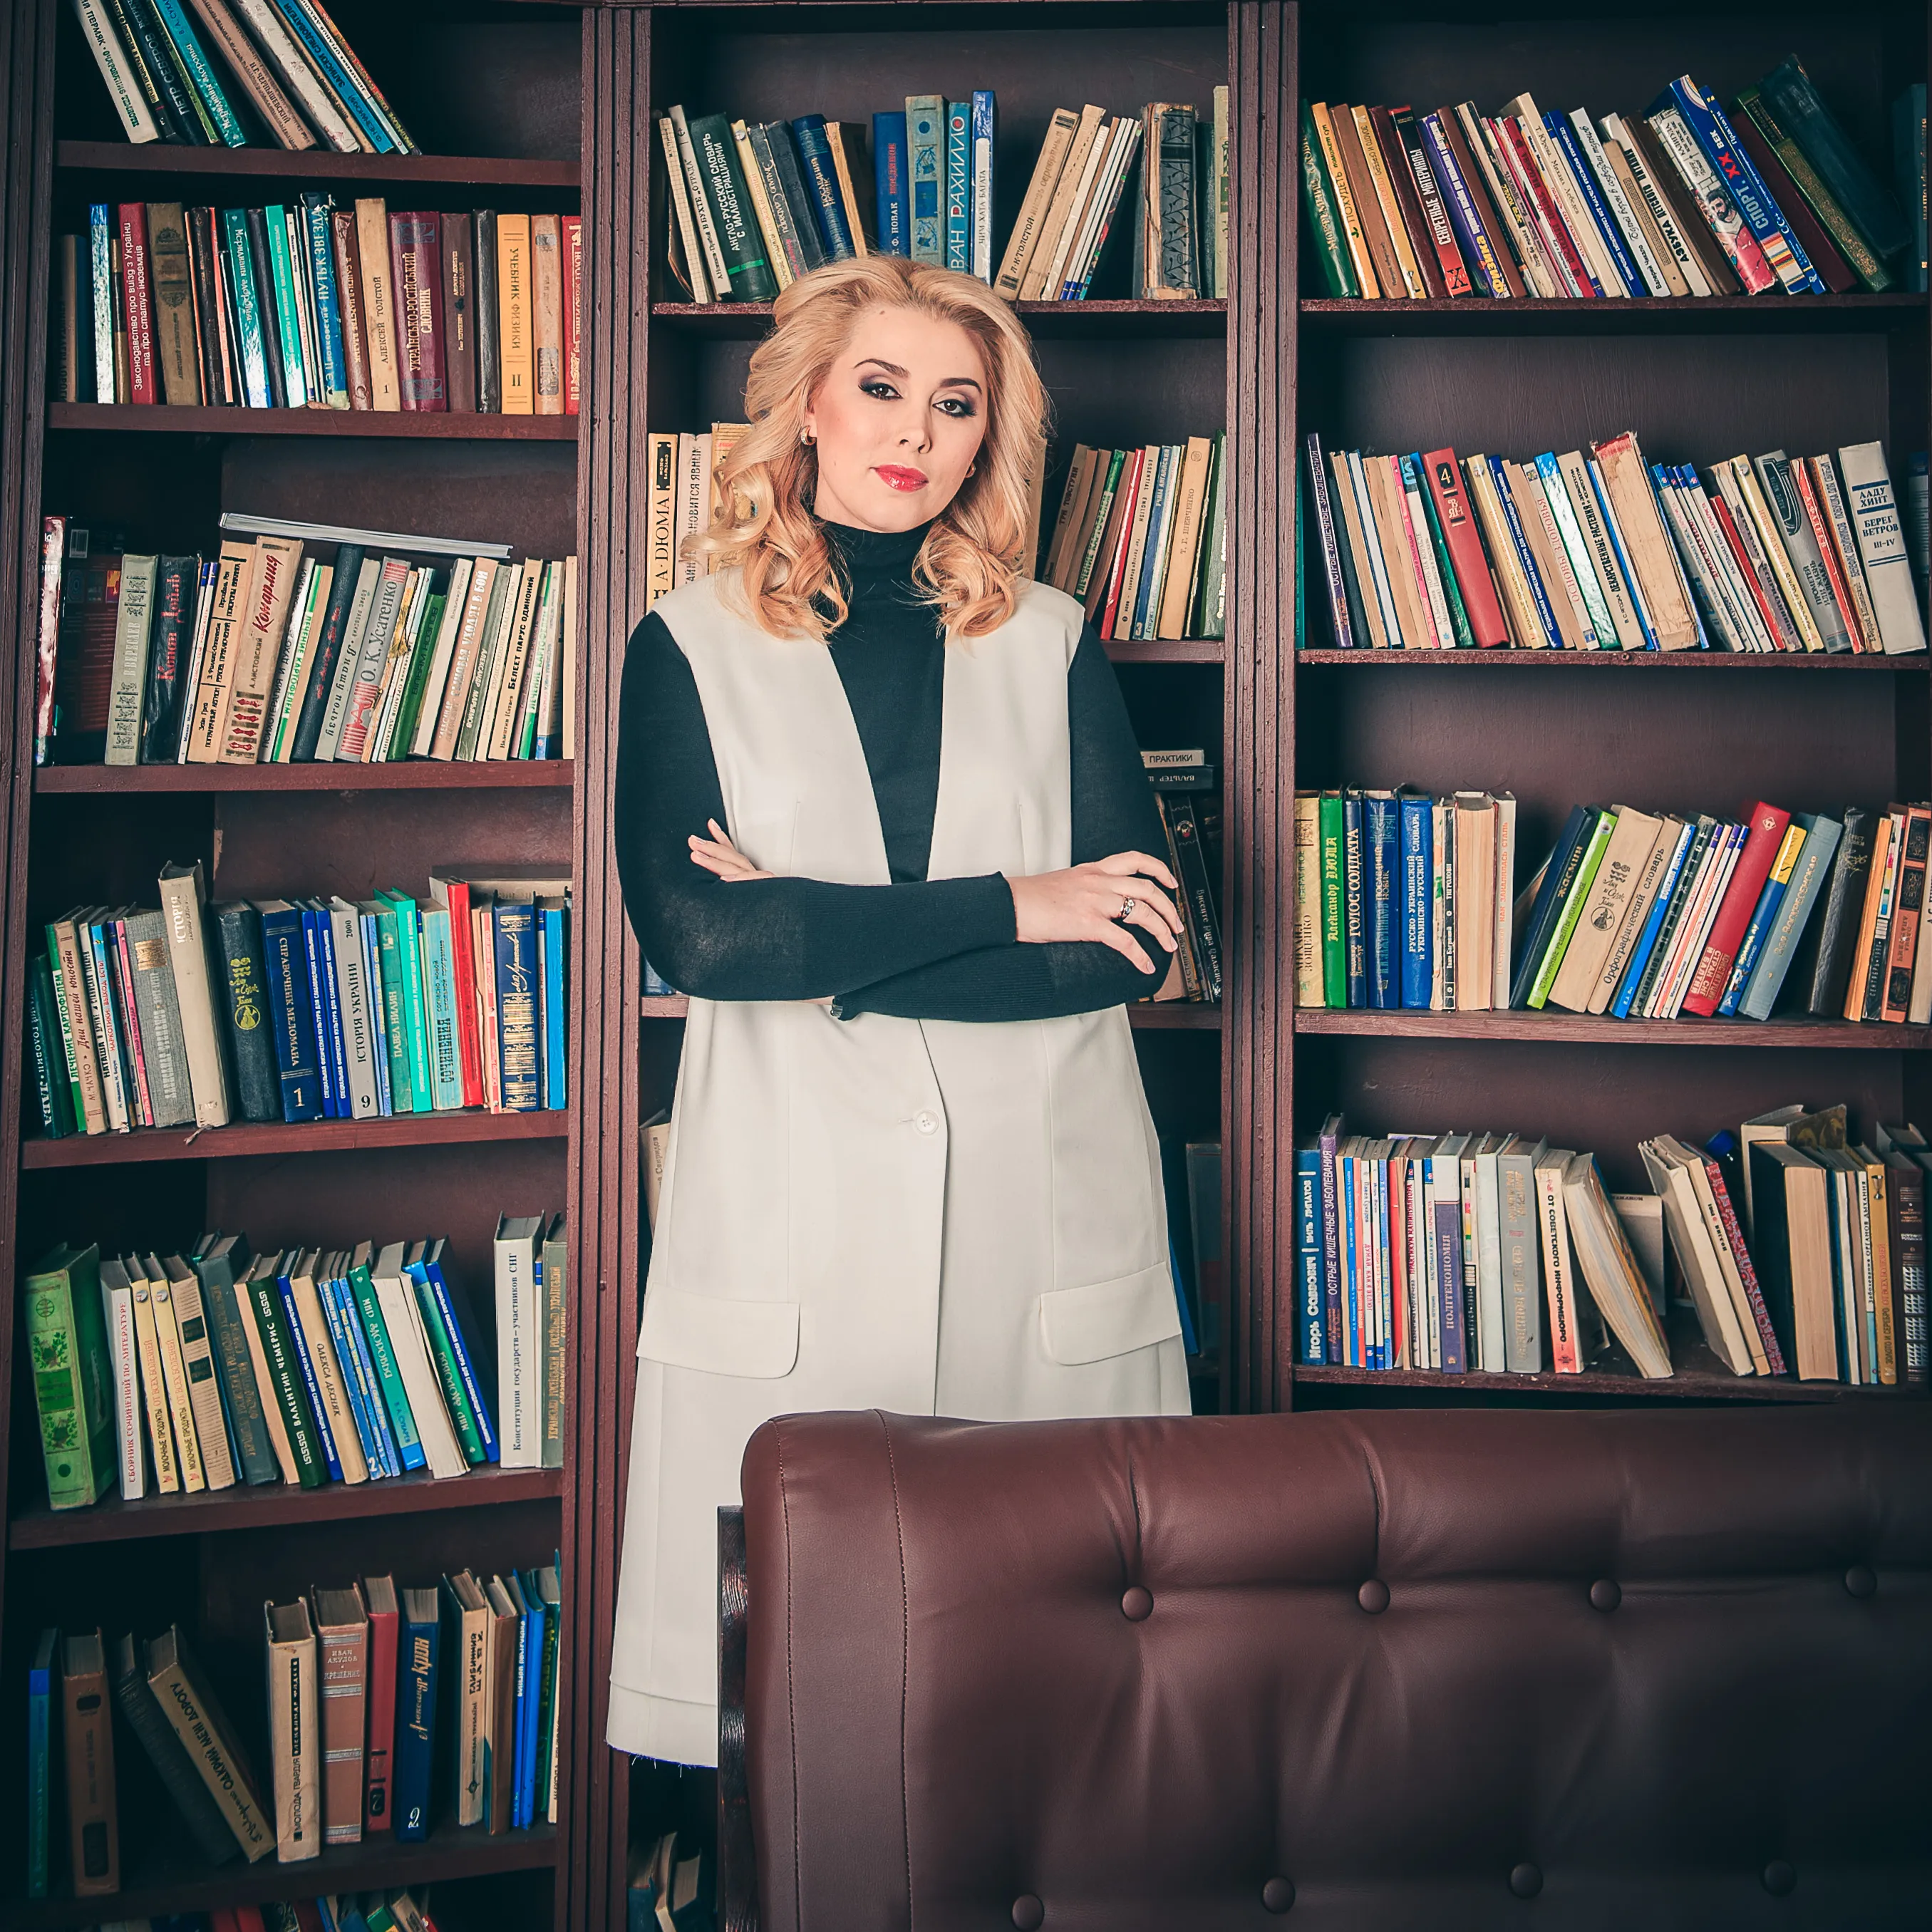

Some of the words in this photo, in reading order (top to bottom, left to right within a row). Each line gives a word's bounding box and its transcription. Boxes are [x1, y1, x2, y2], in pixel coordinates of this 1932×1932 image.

[283, 1, 322, 53] СЛЕДОВАТЕЛЯ
[144, 31, 174, 84] СЕВЕРОВ
[319, 53, 346, 88] ЗАПИСКИ
[169, 84, 189, 115] ПЕТР
[1321, 123, 1330, 136] суп
[1709, 129, 1724, 149] ВЕК
[701, 132, 720, 175] СЛОВАРЬ
[950, 116, 965, 217] РАХИЛЛО
[1323, 137, 1338, 169] поможет
[1409, 148, 1435, 195] МАТЕРИАЛЫ
[1623, 147, 1647, 182] ПИТАНИЯ
[713, 141, 742, 227] ИЛЛЮСТРАЦИЯМИ
[1333, 170, 1355, 222] ПОХУДЕТЬ
[1642, 183, 1666, 219] ДЕТСКОГО
[711, 175, 740, 252] АНГЛО-РУССКИЙ
[890, 202, 899, 233] НОВАК
[1424, 197, 1452, 245] СЕКРЕТНЫЕ
[1733, 178, 1769, 230] СПОРТ.
[122, 222, 134, 259] України
[1660, 219, 1690, 264] АЗБУКА
[134, 245, 146, 289] іноземців
[510, 248, 519, 299] УЧЕБНИК
[1472, 234, 1506, 295] Физика
[1646, 264, 1663, 290] Валерий
[128, 295, 139, 312] про
[373, 276, 384, 316] ТОЛСТОЙ
[401, 252, 422, 371] УКРАЇНСЬКО-РОСІЙСЬКИЙ
[418, 288, 433, 333] СЛОВНИК
[141, 333, 150, 348] про
[377, 321, 388, 364] АЛЕКСЕЙ
[511, 304, 520, 348] ФИЗИКИ
[128, 316, 143, 390] Законодавство
[1143, 459, 1154, 491] ESSENTIAL
[1308, 449, 1327, 505] ЗАБОЛЕВАНИЯ
[1441, 467, 1451, 484] 4
[1138, 497, 1147, 522] ENGLISH
[1182, 488, 1194, 534] ШЕВЧЕНКО
[1861, 495, 1887, 507] ХИНТ
[655, 496, 669, 559] ДЮМА
[1318, 506, 1335, 552] КИШЕЧНЫЕ
[1536, 497, 1563, 552] ЗДОРОВЬЯ
[1581, 503, 1601, 539] РАСТЕНИЯ
[1863, 524, 1899, 537] ВЕТРОВ
[1864, 515, 1893, 527] БЕРЕГ
[1075, 553, 1094, 592] ЛЕЧЕНИЕ
[1087, 493, 1112, 551] КАРТОФЕЛЕМ
[1180, 545, 1187, 554] Т.
[1326, 552, 1340, 586] ОСТРЫЕ
[1557, 555, 1580, 603] ОСНОВЫ
[1594, 537, 1620, 593] ЛЕКАРСТВЕННЫЕ
[1803, 565, 1822, 604] ПРОМЕТЕЙ
[1809, 559, 1824, 587] ЖИЗНЬ
[1817, 562, 1835, 600] БАЛЬЗАКА
[160, 572, 190, 623] Дойль
[251, 554, 288, 634] Конармия
[367, 580, 399, 647] Усатенко
[520, 575, 534, 621] ОДИНОКИЙ
[1819, 587, 1830, 606] ИЛИ
[297, 615, 311, 653] ЛЕЧЕНИЕ
[421, 606, 438, 651] КОЗЛОВ
[448, 647, 470, 697] СЫНОВЬЯ
[460, 604, 481, 646] УХОДЯТ
[471, 569, 488, 593] БОЙ
[515, 623, 526, 652] ПАРУС
[155, 631, 180, 681] Конан
[335, 657, 351, 690] нашу
[359, 666, 376, 683] О.
[474, 649, 488, 687] АЛЕКСАНДР
[507, 654, 520, 690] БЕЛЕЕТ
[528, 671, 540, 710] ЛЕЧЕНИЕ
[534, 610, 549, 667] КАРТОФЕЛЕМ
[283, 656, 301, 714] КАРТОФЕЛЕМ
[261, 678, 284, 748] ПСИХОТЕРАПИЯ
[324, 693, 343, 736] пользу
[465, 689, 480, 728] МАРЬЯМОВ
[1410, 813, 1420, 852] СЛОВАРЬ
[1345, 828, 1361, 890] СОЛДАТА
[344, 919, 353, 938] 2000
[1326, 884, 1342, 941] Александр
[1348, 894, 1360, 936] ГОЛОС
[1602, 892, 1648, 986] Орфографический
[1641, 845, 1665, 891] словарь
[1302, 915, 1314, 971] ЗОЩЕНКО
[1538, 950, 1559, 989] СТАРИННЫЕ
[1554, 919, 1571, 950] РЕЦЕПТЫ
[61, 950, 78, 989] юности
[1690, 955, 1710, 994] БАЛТИИ
[1705, 949, 1722, 978] СТРАН
[53, 973, 71, 1034] КАРТОФЕЛЕМ
[278, 937, 294, 1005] СПРАВОЧНИК
[286, 1007, 301, 1065] МЕЛОМАНА
[346, 963, 361, 1014] УКРАЇНИ
[386, 991, 401, 1023] НИЛИН
[1698, 979, 1710, 996] СНГ
[68, 992, 83, 1026] нашей
[65, 1037, 78, 1078] ЛЕЧЕНИЕ
[75, 1028, 89, 1050] Дни
[353, 1017, 366, 1063] ІСТОРІЯ
[391, 1026, 403, 1057] ПАВЕЛ
[437, 1018, 453, 1083] СОЧИНЕНИЯ
[31, 1026, 45, 1073] ГОЛОВИН
[38, 1080, 53, 1126] ЛАВА
[97, 1041, 110, 1078] НАТАША
[294, 1088, 305, 1107] 1
[359, 1095, 371, 1108] 9
[1323, 1150, 1333, 1208] ЗАБОЛЕВАНИЯ
[1547, 1194, 1554, 1206] ОТ
[1326, 1212, 1336, 1258] КИШЕЧНЫЕ
[1547, 1208, 1561, 1267] СОВЕТСКОГО
[1862, 1221, 1871, 1256] ОРГАНОВ
[508, 1254, 517, 1273] СНГ
[1326, 1261, 1337, 1295] ОСТРЫЕ
[1442, 1234, 1455, 1328] ПОЛІТЕКОНОМІЯ
[361, 1297, 375, 1318] МИР
[1552, 1269, 1568, 1343] ИНФОРМБЮРО
[118, 1301, 129, 1360] ЛИТЕРАТУРЕ
[266, 1322, 285, 1369] ЧЕМЕРИС
[123, 1363, 130, 1376] ПО
[143, 1338, 156, 1375] БОЛЕЗНЕЙ
[165, 1338, 180, 1375] БОЛЕЗНЕЙ
[314, 1343, 332, 1378] ОЛЕКСА
[149, 1376, 159, 1394] ВСЕХ
[152, 1396, 160, 1406] ОТ
[172, 1375, 182, 1393] ВСЕХ
[175, 1394, 185, 1405] ОТ
[280, 1371, 301, 1427] ВАЛЕНТИН
[122, 1378, 133, 1437] СОЧИНЕНИЙ
[154, 1407, 165, 1438] ПРОДУКТЫ
[178, 1407, 191, 1437] ПРОДУКТЫ
[456, 1410, 470, 1431] МИР
[127, 1439, 136, 1482] СБОРНИК
[158, 1440, 170, 1472] МОЛОЧНЫЕ
[184, 1438, 197, 1469] МОЛОЧНЫЕ
[169, 1680, 200, 1723] ДОРОГУ
[192, 1721, 214, 1749] МЕНІ
